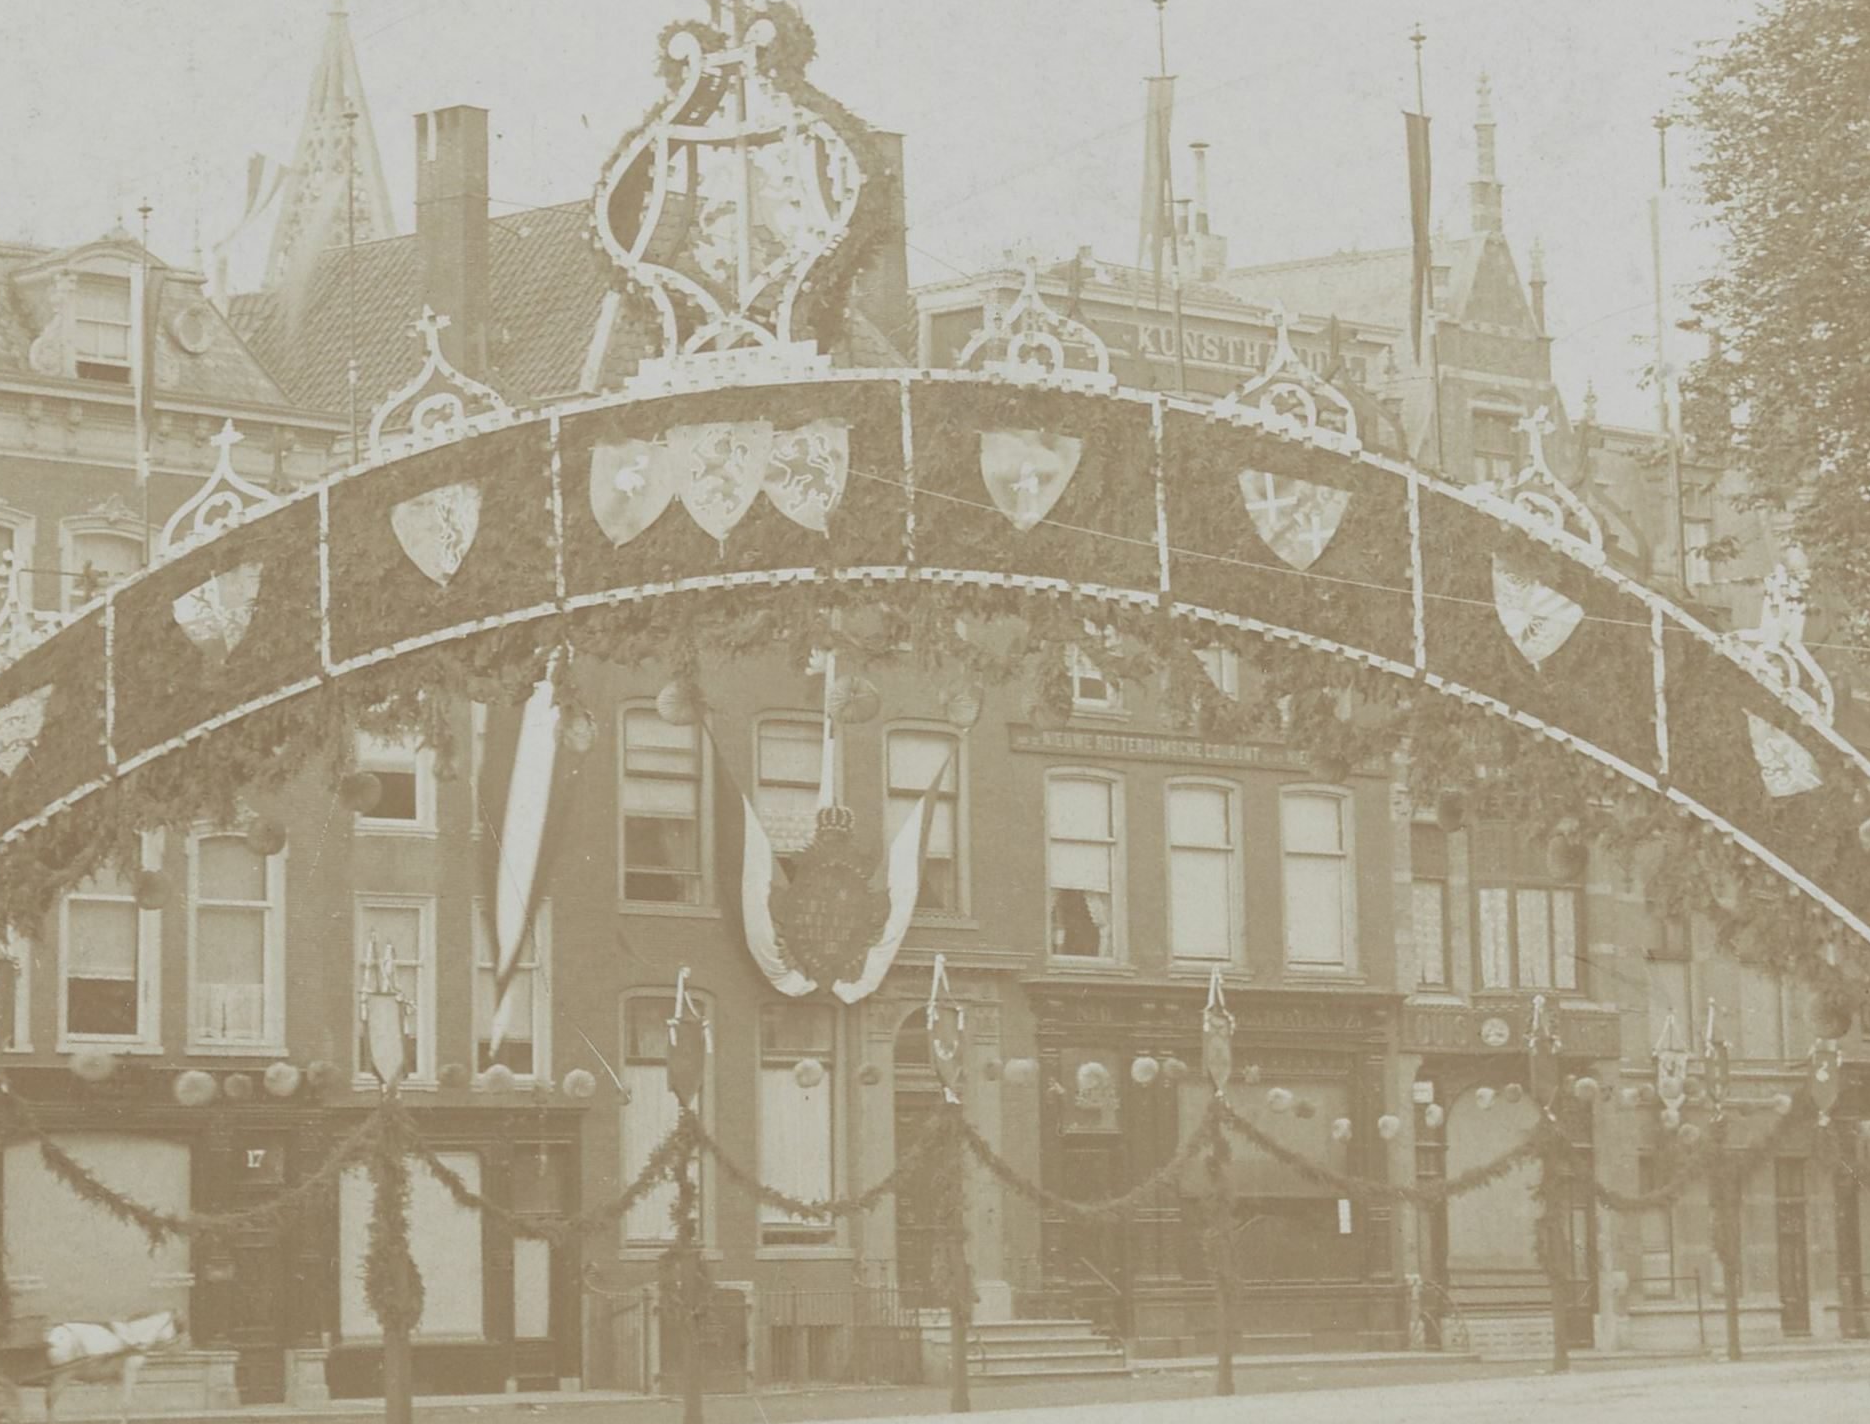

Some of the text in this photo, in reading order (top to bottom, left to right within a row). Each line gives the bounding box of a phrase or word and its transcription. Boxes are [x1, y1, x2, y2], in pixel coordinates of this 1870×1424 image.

[1137, 326, 1365, 382] KUNSTHNDL
[1042, 730, 1094, 750] NIEUWE
[1095, 734, 1203, 759] ROTTERDAMSCHE
[246, 1149, 267, 1168] 17
